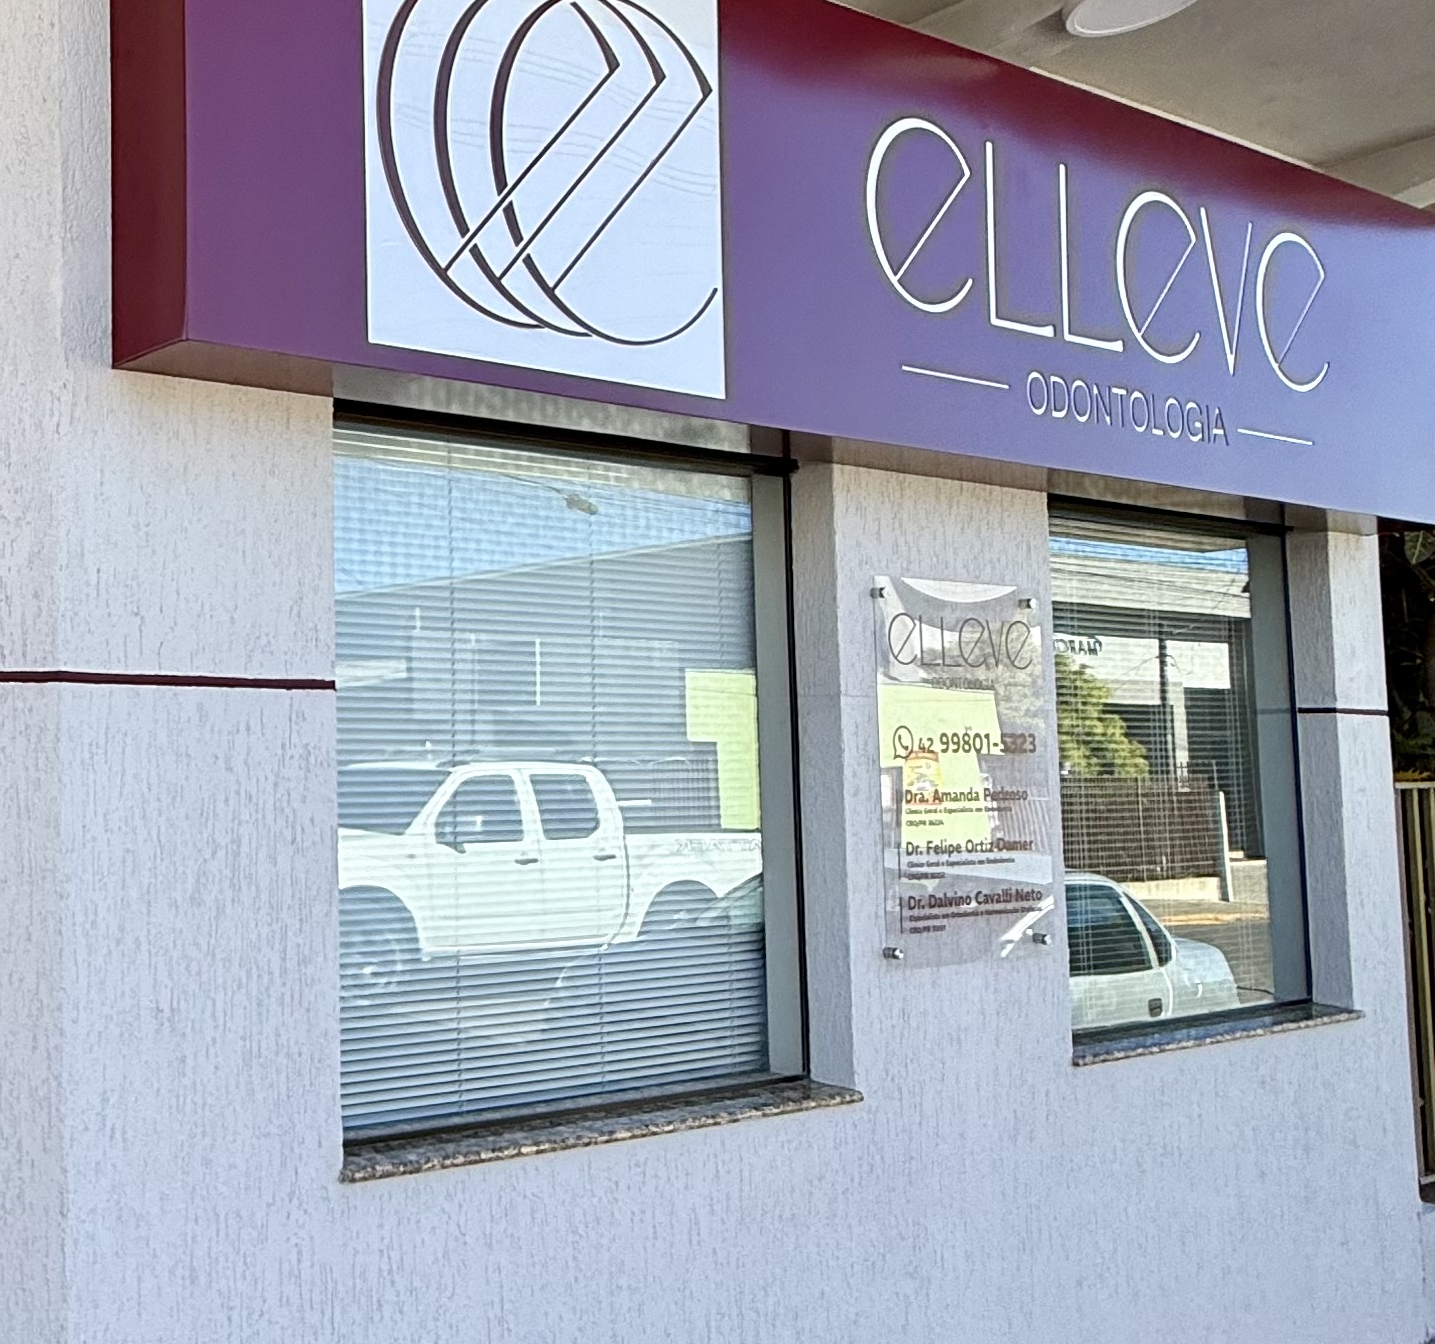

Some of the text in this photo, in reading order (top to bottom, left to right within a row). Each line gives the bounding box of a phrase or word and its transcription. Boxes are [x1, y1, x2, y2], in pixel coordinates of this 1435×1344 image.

[1025, 369, 1230, 448] ODONTOLOGIA
[918, 732, 1037, 754] 42 99801-5323
[904, 789, 929, 804] Dra.
[932, 786, 980, 803] Amanda
[906, 841, 923, 857] Dr.
[926, 838, 963, 858] Felipe
[965, 837, 994, 853] Ortiz
[908, 886, 1043, 911] Dr. Dalvino Cavalli Neto
